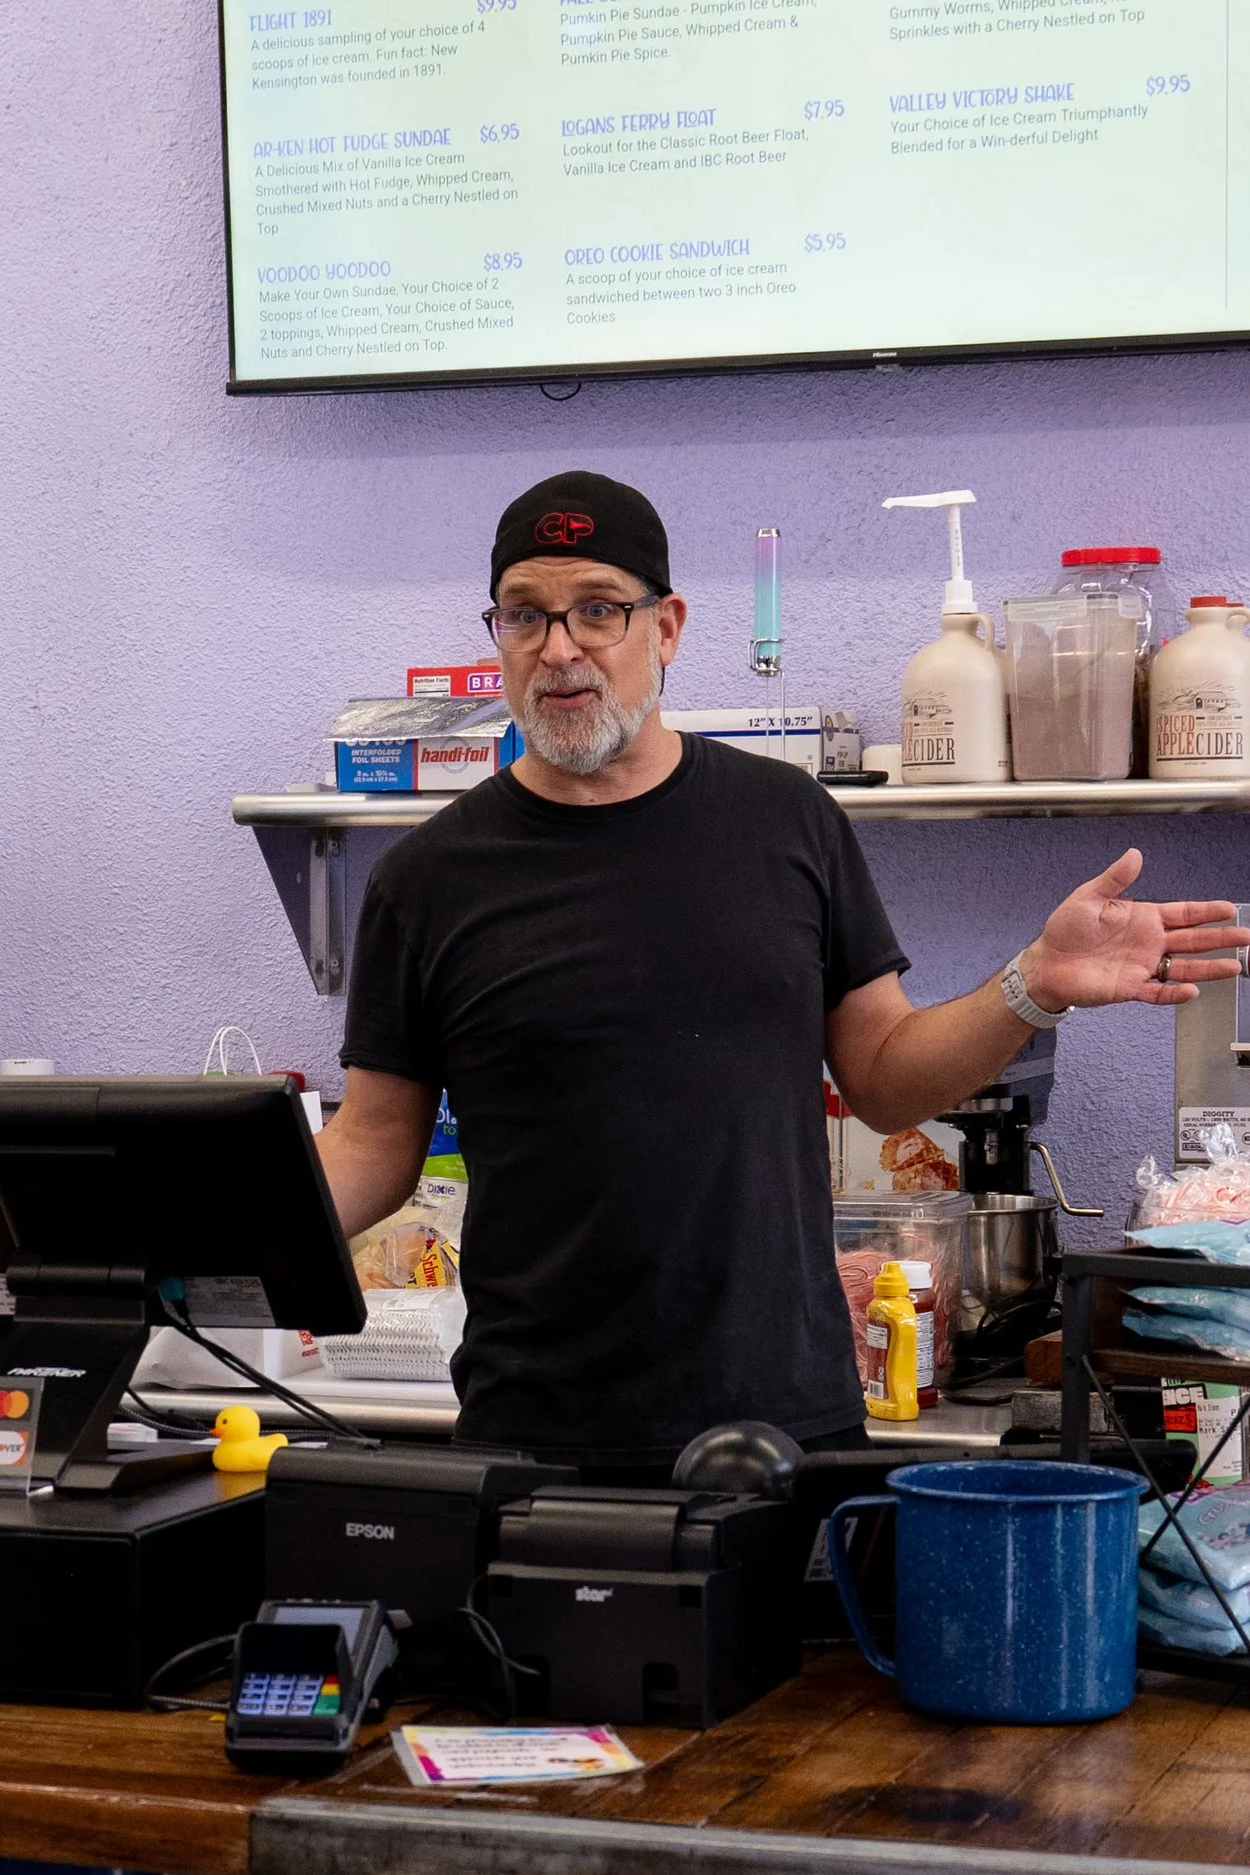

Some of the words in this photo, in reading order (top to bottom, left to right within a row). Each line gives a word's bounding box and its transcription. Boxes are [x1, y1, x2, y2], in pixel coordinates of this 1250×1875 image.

[249, 10, 296, 32] FLIGHT
[303, 8, 332, 28] 1891
[251, 74, 317, 90] Kensington
[319, 74, 344, 85] was
[346, 67, 396, 83] founded
[398, 66, 410, 79] in
[1145, 76, 1191, 96] $9.95
[888, 91, 947, 112] VALLEY
[952, 87, 1019, 108] VICTORY
[1024, 83, 1073, 104] SHAKE
[803, 101, 846, 121] $7.95
[890, 121, 919, 134] Your
[922, 117, 969, 132] Choice
[971, 115, 985, 129] of
[989, 115, 1009, 128] Ice
[1012, 113, 1057, 126] Cream
[1062, 106, 1148, 124] Triumphantly
[479, 124, 520, 144] $6.95
[561, 116, 615, 137] LOGANS
[621, 112, 670, 133] FERRY
[676, 109, 718, 129] FLOAT
[253, 137, 304, 158] AR-KEN
[308, 135, 335, 154] HOT
[342, 132, 388, 152] FUDGE
[393, 128, 451, 149] SUNDAE
[562, 141, 613, 156] Lookout
[616, 140, 633, 153] for
[636, 138, 656, 152] the
[659, 135, 705, 150] Classic
[708, 133, 738, 147] Root
[740, 132, 769, 145] Beer
[773, 128, 810, 143] Float,
[890, 138, 943, 154] Blended
[946, 137, 965, 150] for
[968, 139, 977, 149] a
[980, 131, 1048, 148] Win-derful
[1051, 128, 1098, 145] Delight
[254, 165, 264, 178] A
[265, 162, 319, 177] Delicious
[321, 160, 343, 173] Mix
[346, 158, 359, 172] of
[361, 156, 401, 171] Vanilla
[404, 155, 422, 168] Ice
[424, 153, 465, 166] Cream
[257, 222, 279, 237] Top
[563, 246, 605, 266] OREO
[609, 243, 662, 263] COOKIE
[669, 238, 750, 260] SANDWICH
[803, 234, 847, 252] $5.95
[483, 253, 523, 272] $8.95
[256, 264, 321, 284] VOODOO
[565, 310, 616, 324] Cookies
[534, 511, 595, 545] CP
[1156, 715, 1195, 733] SPICED
[420, 746, 490, 764] handi-foil
[1156, 732, 1195, 756] APPLE
[1196, 732, 1243, 755] CIDER
[352, 756, 370, 764] FOIL
[345, 1522, 395, 1540] EPSON
